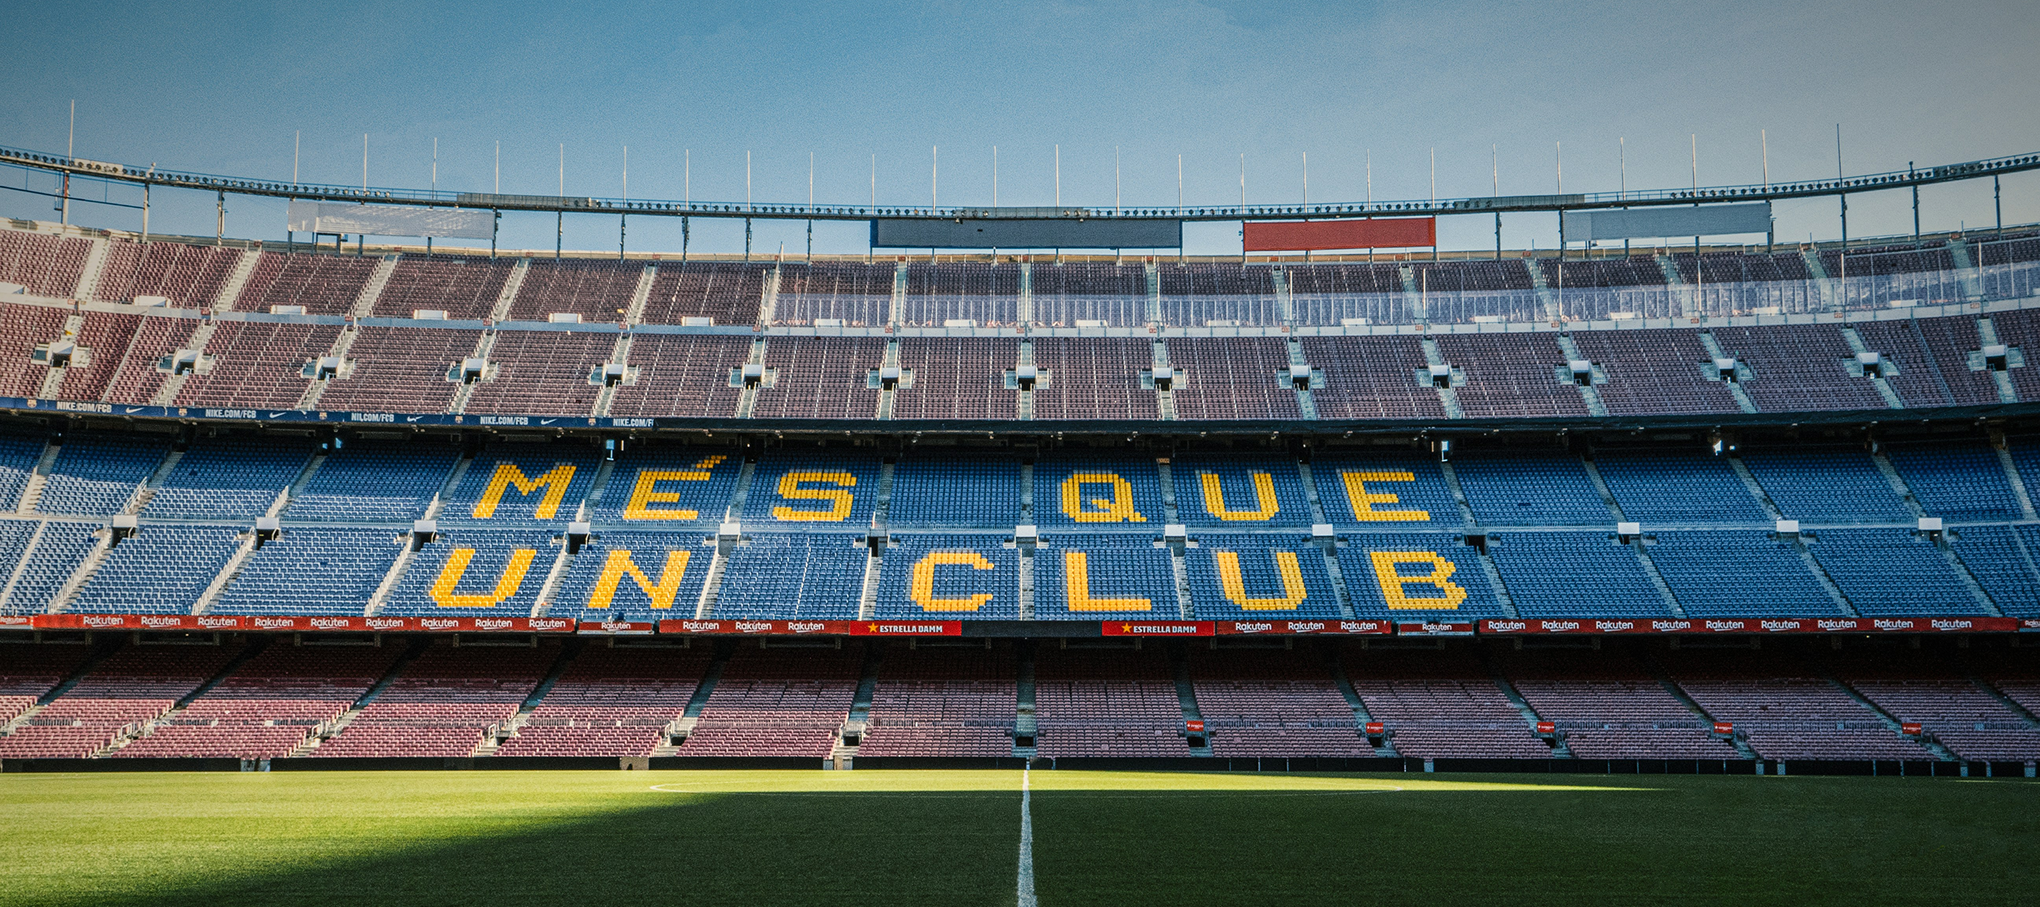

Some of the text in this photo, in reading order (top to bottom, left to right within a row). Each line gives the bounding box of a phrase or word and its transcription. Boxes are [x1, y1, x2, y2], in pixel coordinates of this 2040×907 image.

[56, 401, 112, 413] NIKE.COM/FCB
[205, 408, 257, 419] NIKE.COM/FCB
[480, 416, 529, 426] NIKE.COM/FCB
[473, 455, 1430, 522] MÉS QUE
[430, 549, 1467, 611] UN CLUB
[83, 616, 237, 627] Rakuten Rakuten Rakuten
[254, 617, 404, 629] Rakuten Rakuten Rakuten
[421, 618, 567, 629] Rakuten Rakuten Rakuten
[601, 622, 631, 630] Rakuten
[682, 621, 825, 631] Rakuten Rakuten Rakuten
[1235, 622, 1378, 632] Rakuten Rakuten Rakuten
[1422, 623, 1453, 631] Rakuten
[1488, 620, 1972, 631] Rakuten Rakuten Rakuten Rakuten Rakuten Rakuten Rakuten Rakuten Rakuten
[879, 625, 943, 633] ESTRELLA DAMM
[1133, 625, 1197, 633] ESTRELLA DAMM
